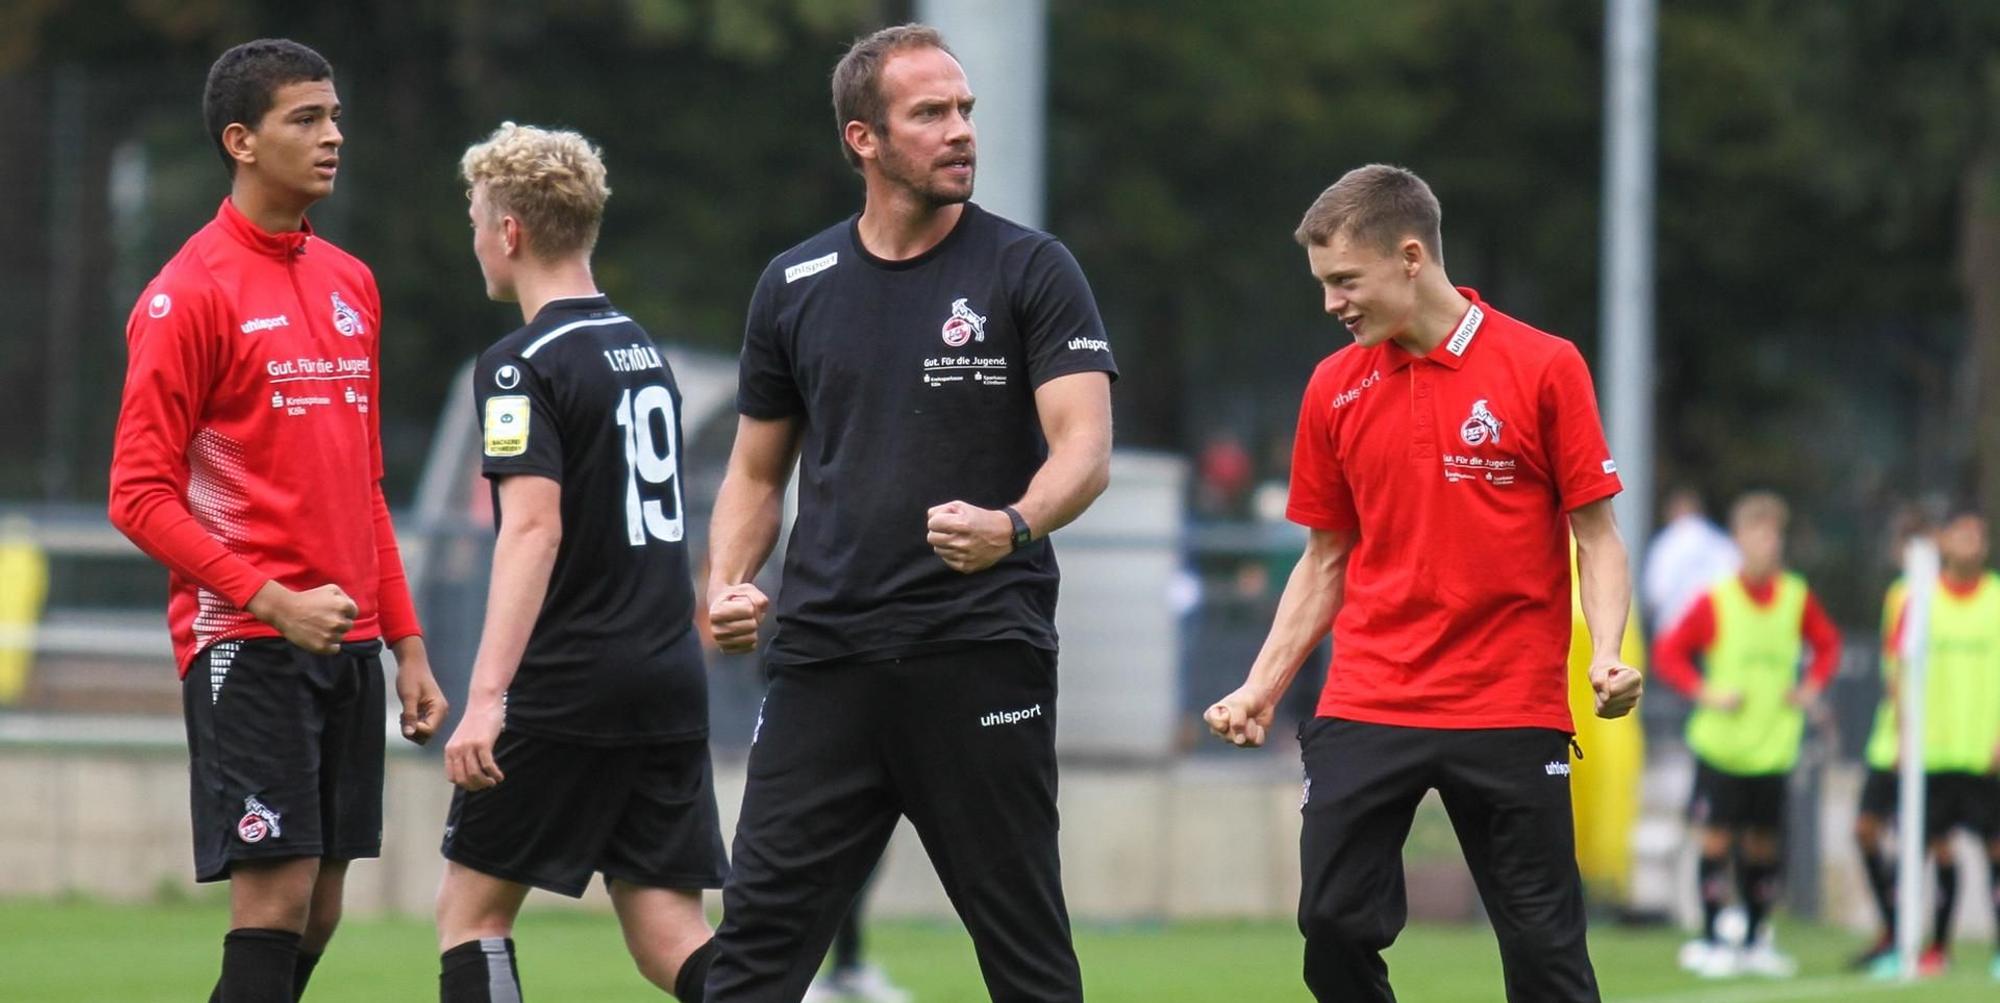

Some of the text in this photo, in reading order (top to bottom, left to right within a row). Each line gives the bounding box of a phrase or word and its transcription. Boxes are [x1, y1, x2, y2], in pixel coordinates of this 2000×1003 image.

[787, 254, 836, 279] uhlsport
[240, 314, 289, 334] uhlsport
[1451, 308, 1481, 353] uhlsport
[266, 359, 298, 376] Gut.
[923, 355, 1008, 368] Gut. Für die Jugend.
[615, 384, 685, 546] 19
[1455, 455, 1469, 465] Für
[1469, 456, 1483, 466] die
[980, 703, 1042, 727] uhlsport
